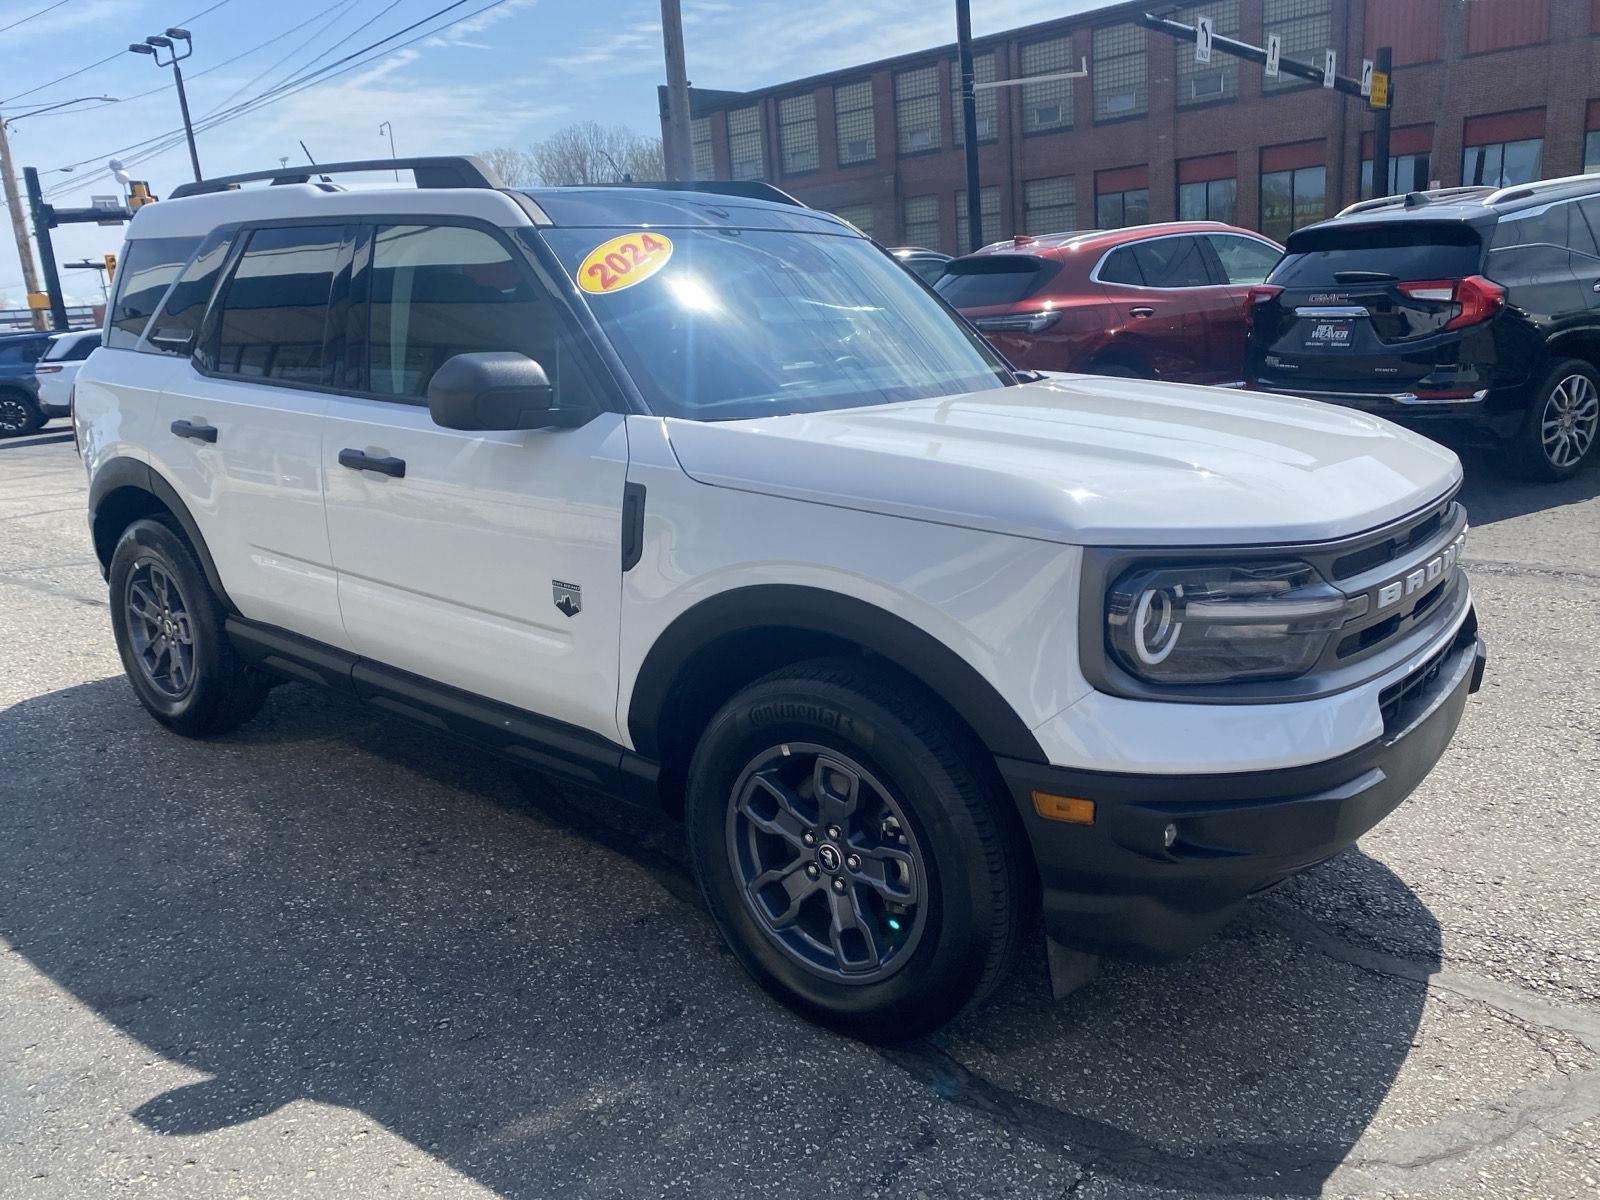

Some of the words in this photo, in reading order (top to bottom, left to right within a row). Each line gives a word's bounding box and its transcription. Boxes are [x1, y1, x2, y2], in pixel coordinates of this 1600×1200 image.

[588, 234, 664, 289] 2024
[1308, 293, 1349, 303] GMC
[1316, 324, 1335, 332] RICK
[1311, 331, 1349, 339] WEAVER
[1377, 523, 1469, 609] BRONC
